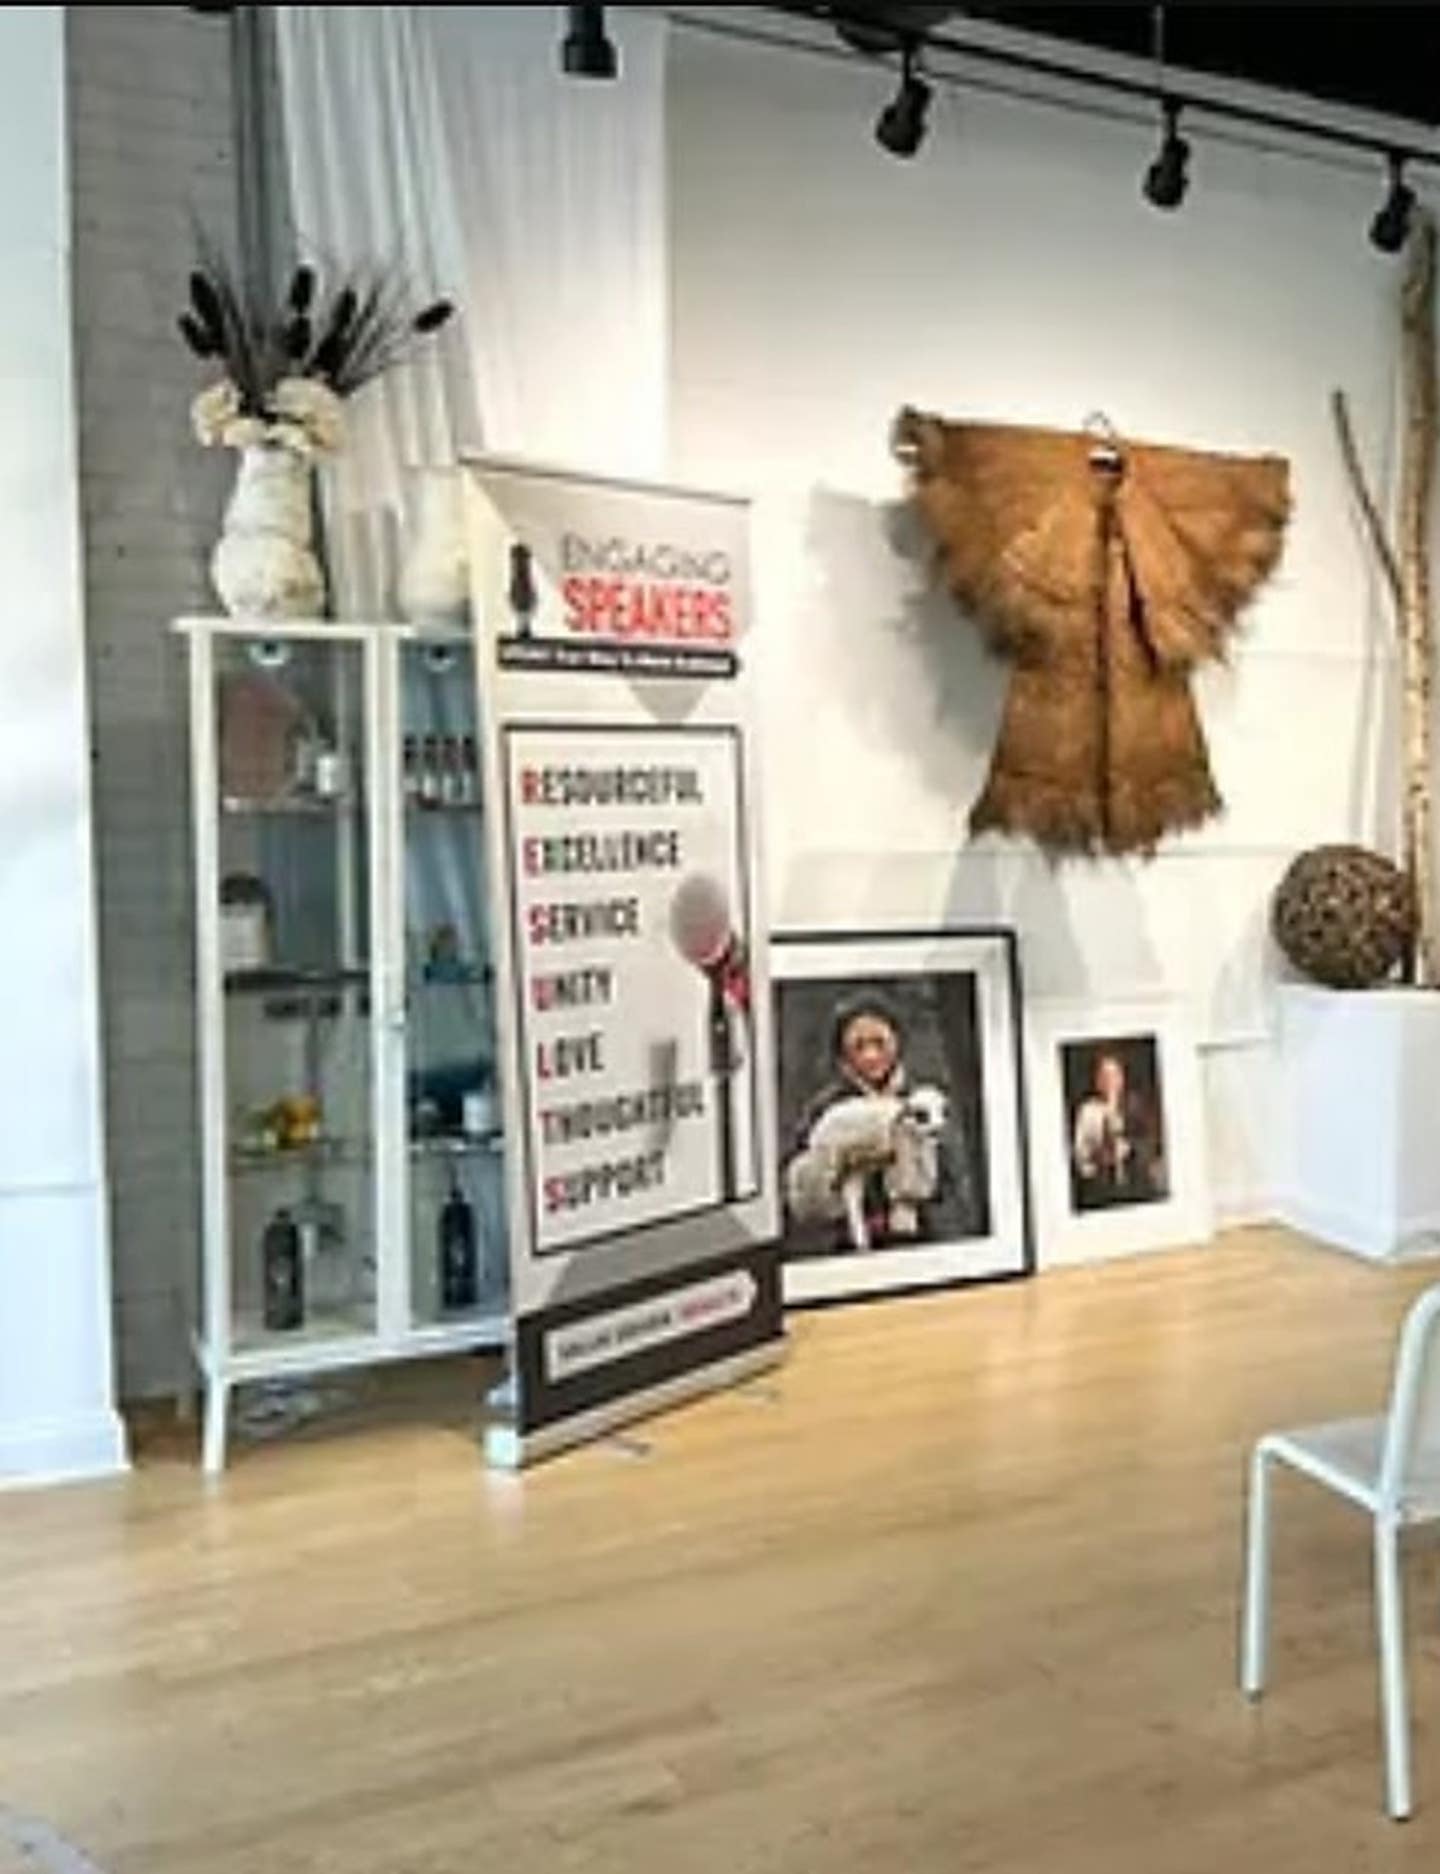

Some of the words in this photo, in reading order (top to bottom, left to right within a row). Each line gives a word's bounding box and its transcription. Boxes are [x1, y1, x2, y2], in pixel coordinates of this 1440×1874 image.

[562, 576, 732, 639] SPEAKERS
[521, 766, 704, 804] RESOURCEFUL
[523, 831, 680, 874] EXCELLENCE
[529, 898, 639, 943] SERVICE
[532, 968, 611, 1011] UNITY
[537, 1032, 604, 1078] LOVE
[538, 1082, 704, 1143] THOUGHTFUL
[543, 1150, 666, 1213] SUPPORT
